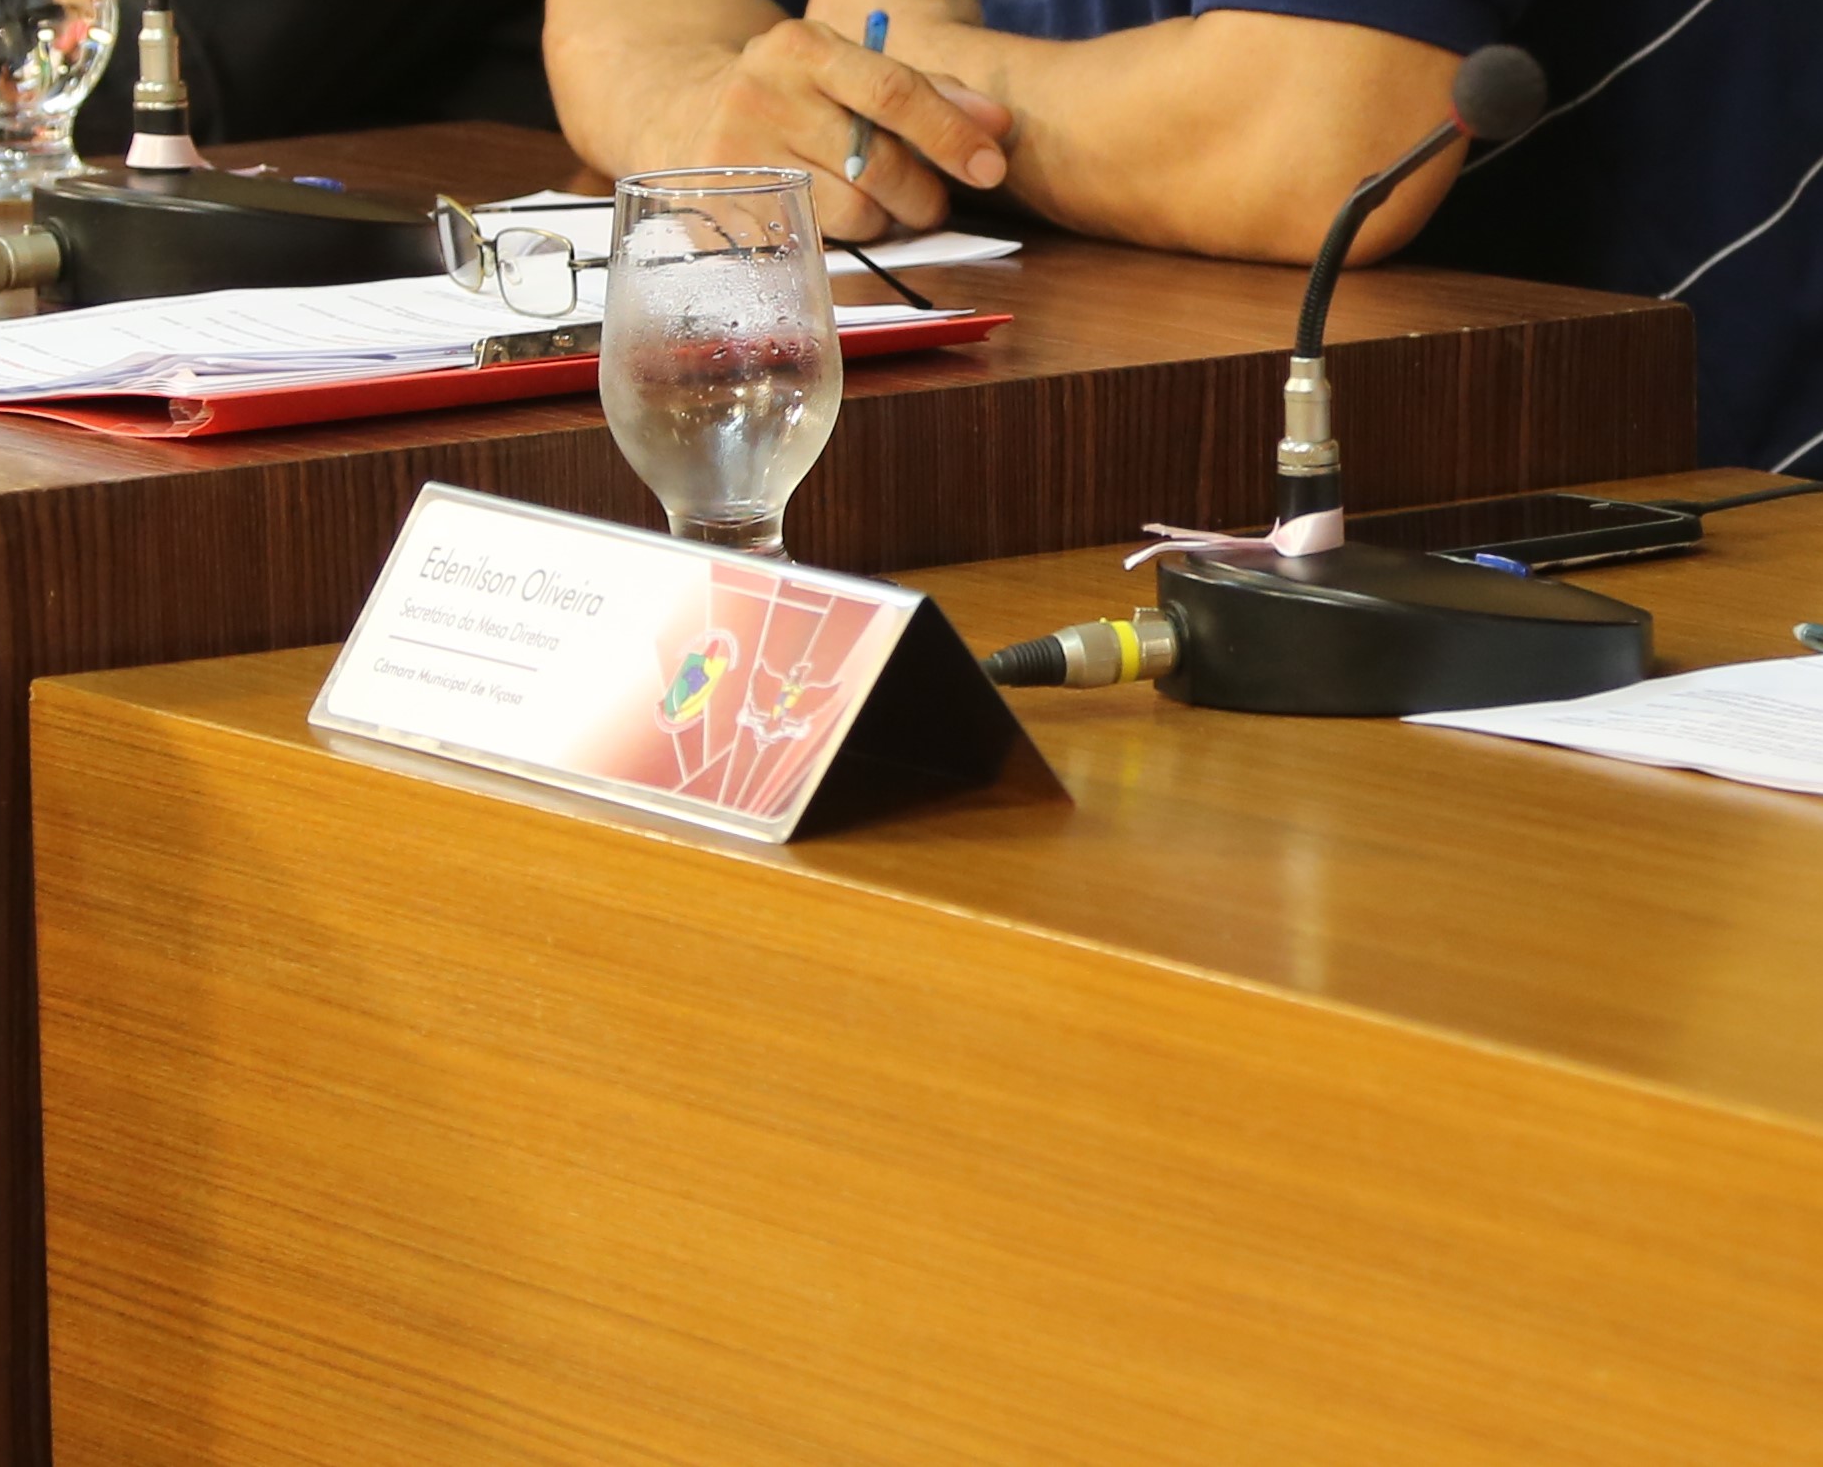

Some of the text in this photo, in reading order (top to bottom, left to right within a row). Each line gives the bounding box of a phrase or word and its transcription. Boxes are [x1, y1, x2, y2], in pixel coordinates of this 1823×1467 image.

[419, 545, 605, 617] Edenilson Oliveira
[399, 597, 561, 652] Secretário da Mesa Diretora
[373, 657, 524, 705] Câmara Municipal de Viçosa
